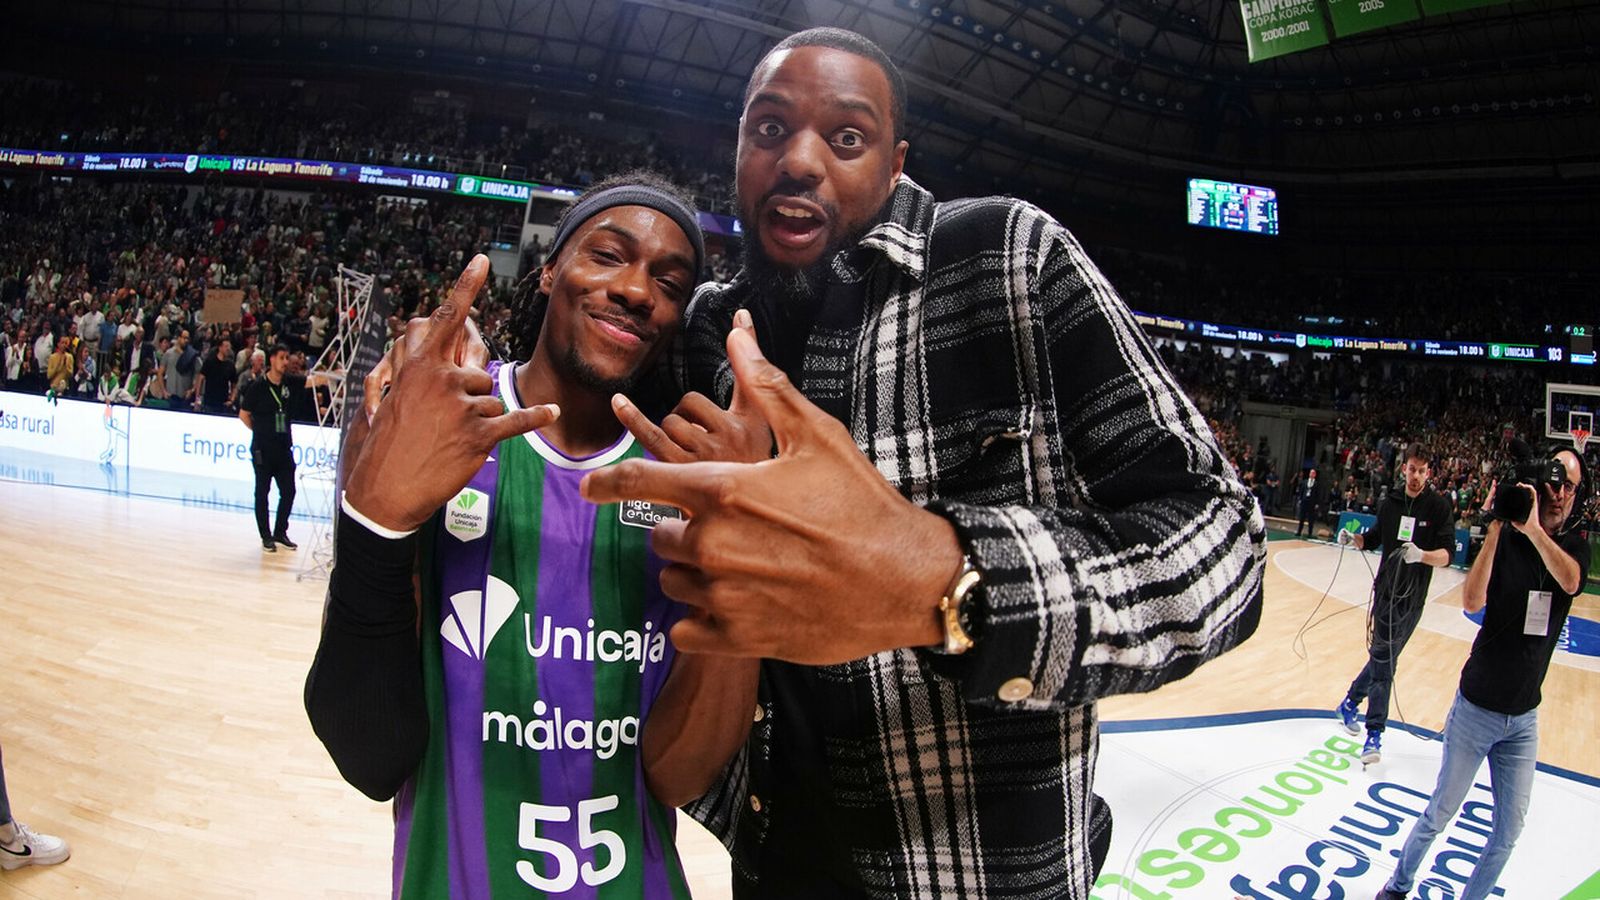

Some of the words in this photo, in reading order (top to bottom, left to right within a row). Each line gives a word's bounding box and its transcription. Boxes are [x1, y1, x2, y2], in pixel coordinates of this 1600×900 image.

[1358, 0, 1384, 13] 2005
[1249, 13, 1278, 28] COPA
[1279, 3, 1315, 20] KORAC
[1261, 20, 1310, 42] 2000/2001
[9, 151, 34, 165] Laguna
[35, 153, 65, 166] Tenerife
[120, 158, 141, 168] 18.00
[199, 157, 231, 172] Unicaja
[232, 158, 246, 170] VS
[246, 159, 258, 171] La
[258, 160, 292, 175] Laguna
[294, 162, 333, 176] Tenerife
[412, 174, 441, 188] 18.00
[441, 177, 449, 189] h
[481, 181, 529, 199] UNICAJA
[1237, 330, 1257, 341] 18.00
[1573, 326, 1585, 336] 0.2
[1307, 335, 1333, 349] Unicaja
[1334, 337, 1344, 348] VS
[1344, 338, 1353, 348] La
[1354, 339, 1379, 351] Laguna
[1379, 340, 1407, 351] Tenerife
[1459, 345, 1478, 355] 18.00
[1504, 346, 1534, 358] UNICAJA
[1548, 347, 1562, 361] 103
[22, 415, 55, 436] rural
[450, 510, 483, 521] Fundación
[455, 519, 478, 529] Unicaja
[524, 612, 666, 674] Unicaja
[515, 794, 627, 893] 55
